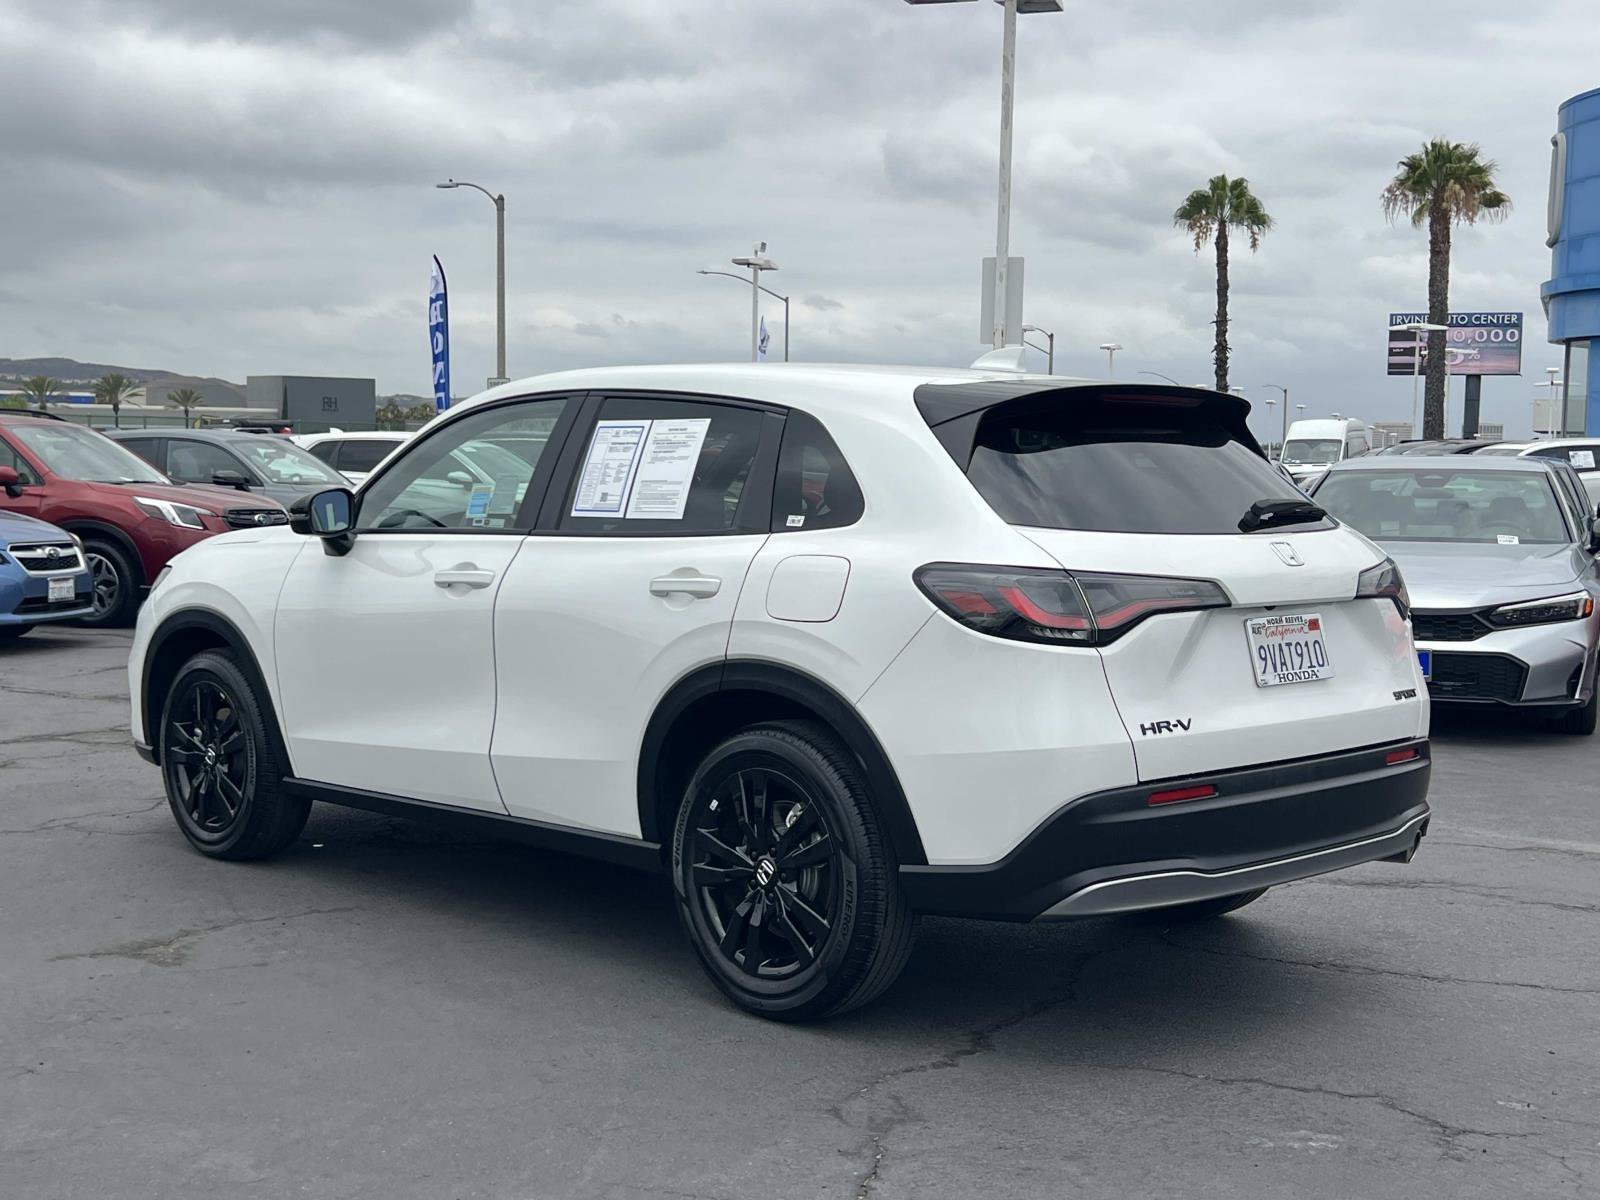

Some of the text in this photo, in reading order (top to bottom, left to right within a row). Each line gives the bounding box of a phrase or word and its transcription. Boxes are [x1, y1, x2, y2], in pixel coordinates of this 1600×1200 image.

[1393, 314, 1518, 325] IRVINE UTO CENTER
[1446, 329, 1519, 345] 0,000
[322, 396, 338, 409] RH
[1265, 625, 1305, 640] California
[1258, 639, 1325, 675] 9VAT910
[1277, 669, 1319, 683] HONDA
[1140, 717, 1191, 736] HR-V
